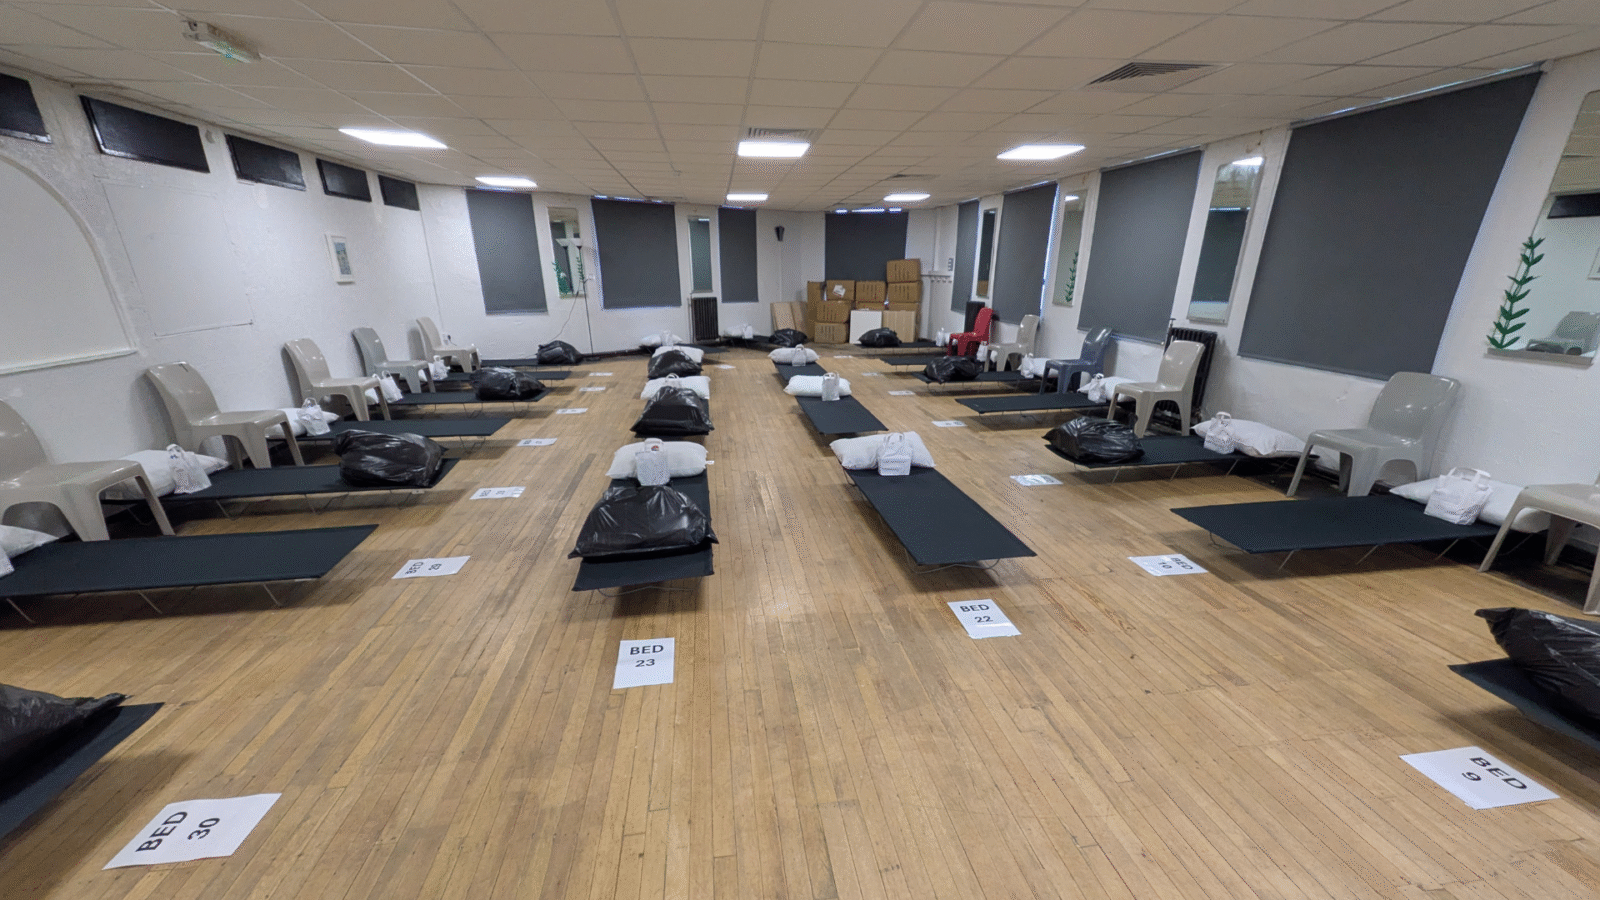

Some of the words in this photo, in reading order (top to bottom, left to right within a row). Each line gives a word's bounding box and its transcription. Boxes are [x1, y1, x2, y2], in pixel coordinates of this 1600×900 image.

[1158, 561, 1173, 569] 10
[1171, 557, 1194, 570] BED
[959, 603, 990, 613] BED
[974, 615, 994, 623] 22
[629, 644, 664, 655] BED
[635, 658, 656, 668] 23
[1461, 771, 1482, 782] 9
[1469, 756, 1527, 789] BED
[135, 811, 188, 853] BED
[187, 817, 220, 841] 30
